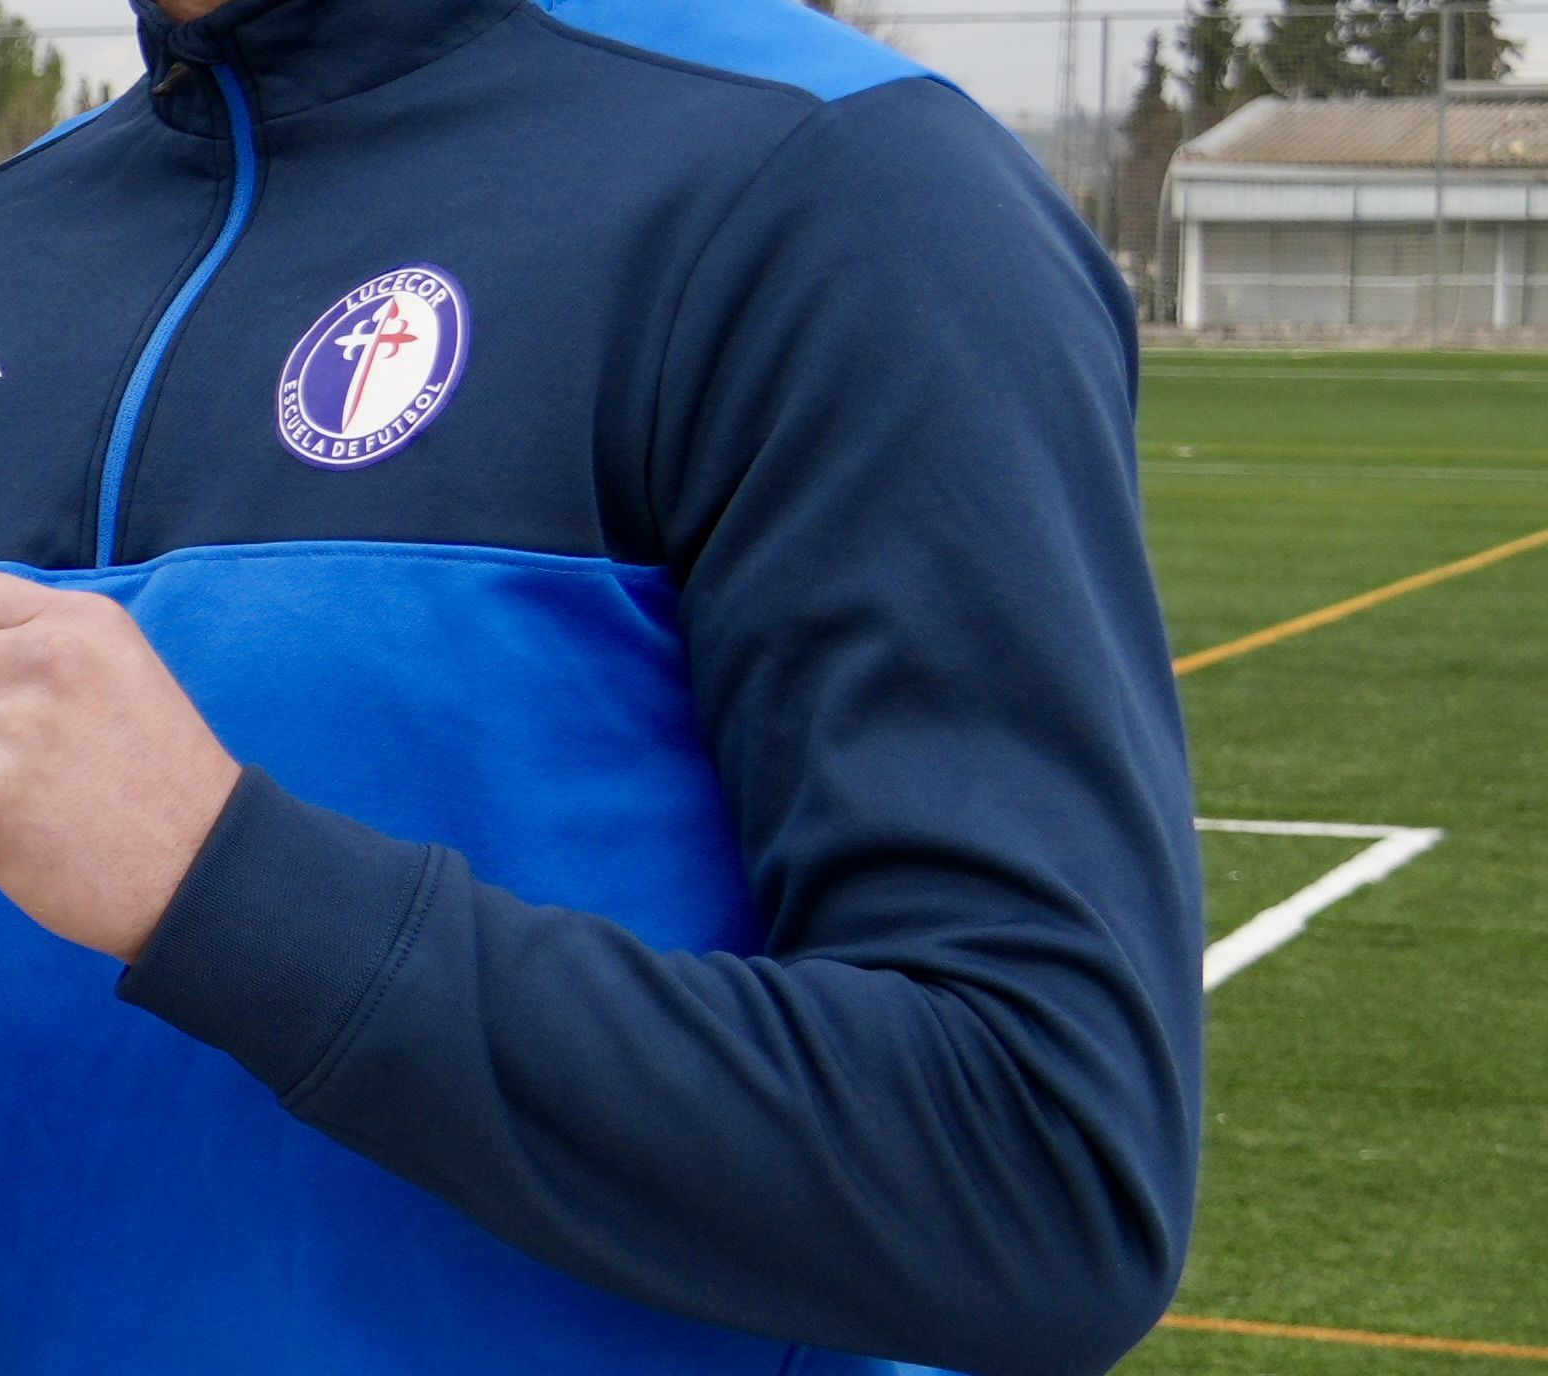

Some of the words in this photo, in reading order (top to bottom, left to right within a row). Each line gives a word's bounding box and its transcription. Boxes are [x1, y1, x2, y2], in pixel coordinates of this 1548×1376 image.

[345, 273, 447, 312] LUCECOR
[284, 380, 324, 454] ESCUELA
[332, 441, 358, 457] DE
[366, 382, 443, 452] FUTBOL
